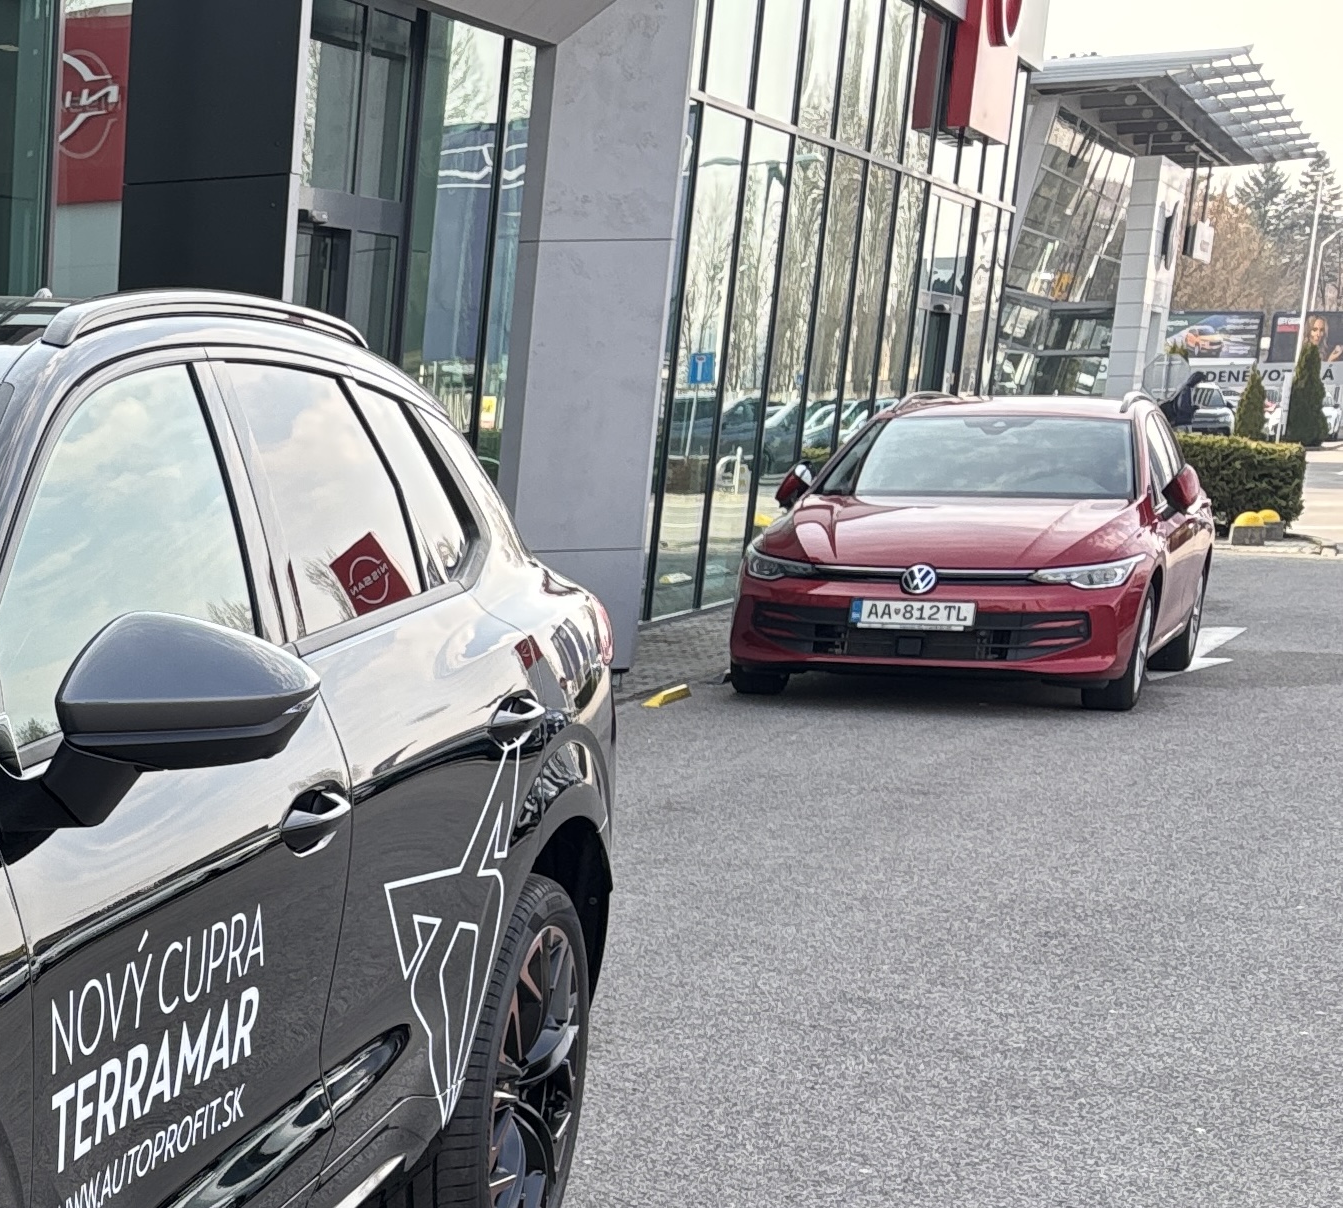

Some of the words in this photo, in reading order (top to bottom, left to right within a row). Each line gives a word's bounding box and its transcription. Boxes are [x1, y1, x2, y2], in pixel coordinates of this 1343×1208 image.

[867, 603, 892, 619] AA
[50, 928, 155, 1076] NOVÝ
[158, 903, 265, 1014] CUPRA
[51, 986, 259, 1175] TERRAMAR
